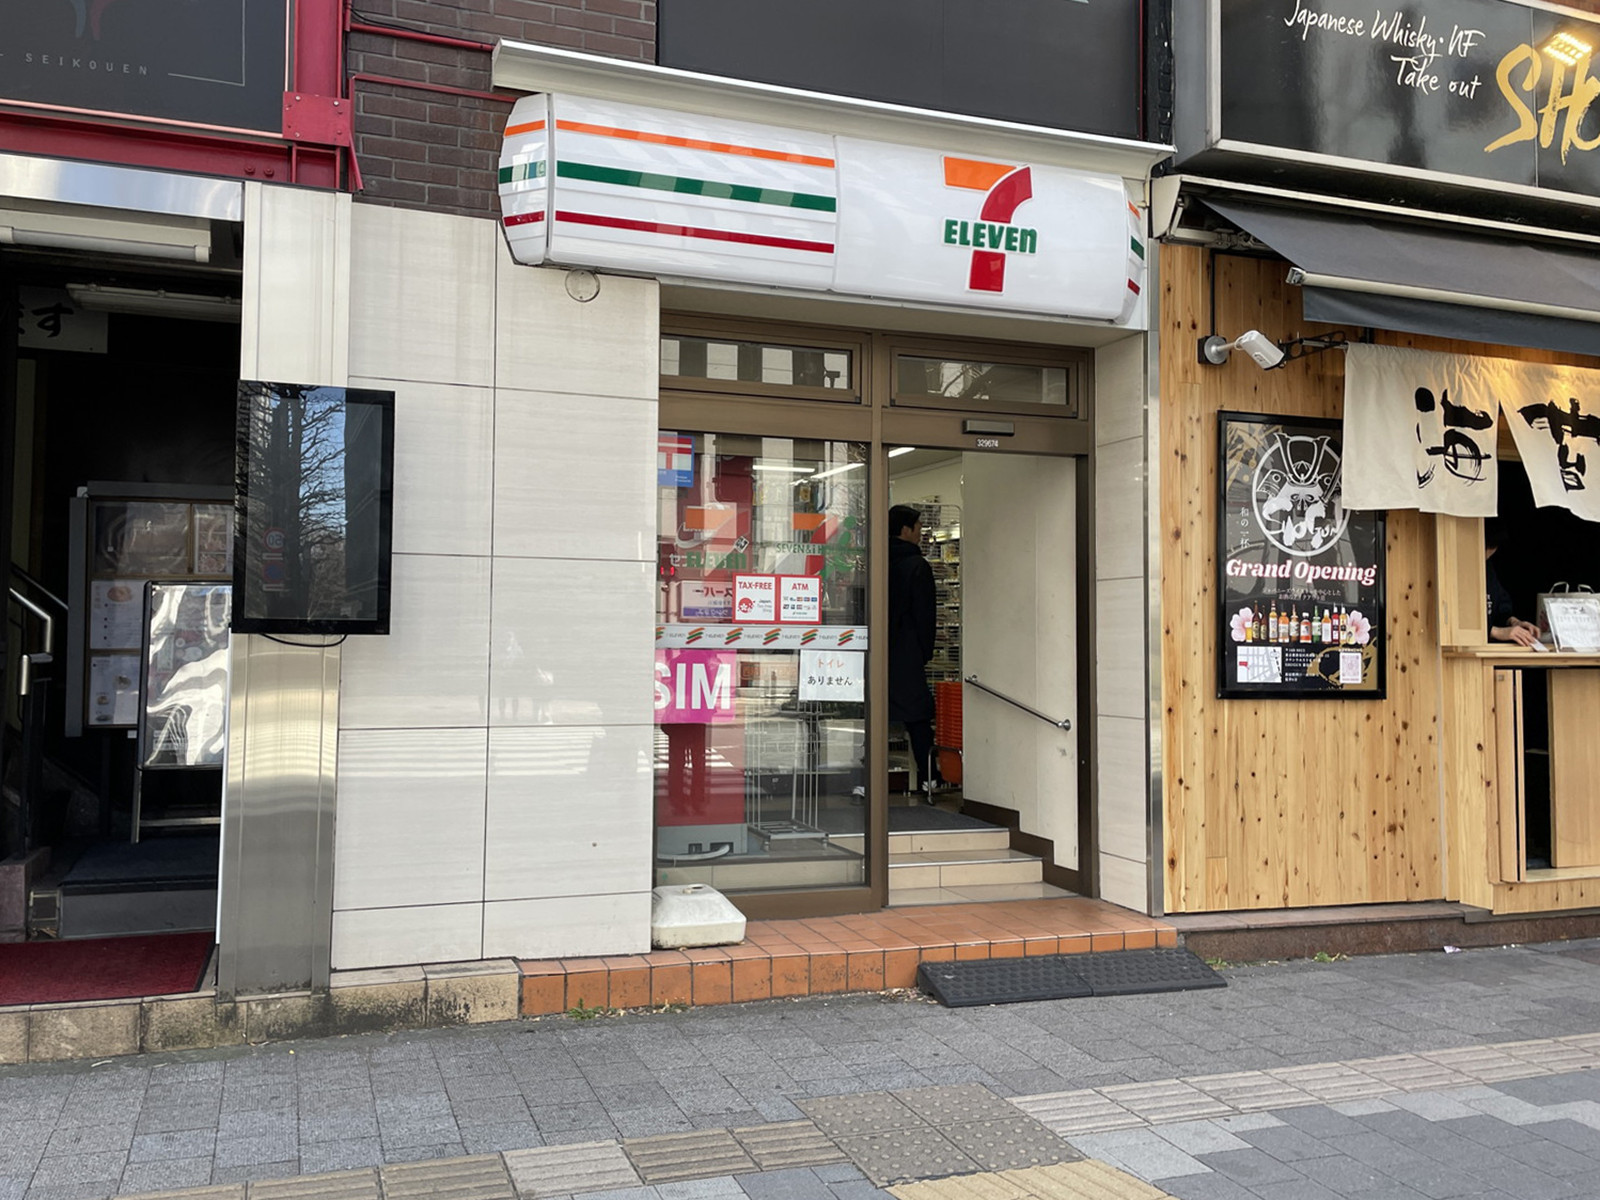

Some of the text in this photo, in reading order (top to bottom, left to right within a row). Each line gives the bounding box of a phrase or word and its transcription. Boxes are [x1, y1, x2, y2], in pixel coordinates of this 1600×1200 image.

[1284, 0, 1365, 41] Japanese
[25, 52, 148, 76] SEIKOUEN
[1391, 54, 1482, 100] Take out
[1226, 558, 1378, 586] Grand Opening
[738, 581, 773, 591] TAX-FREE
[791, 582, 809, 591] ATM
[817, 658, 845, 669] トイレ
[654, 662, 732, 710] SIM
[807, 675, 853, 686] ありません
